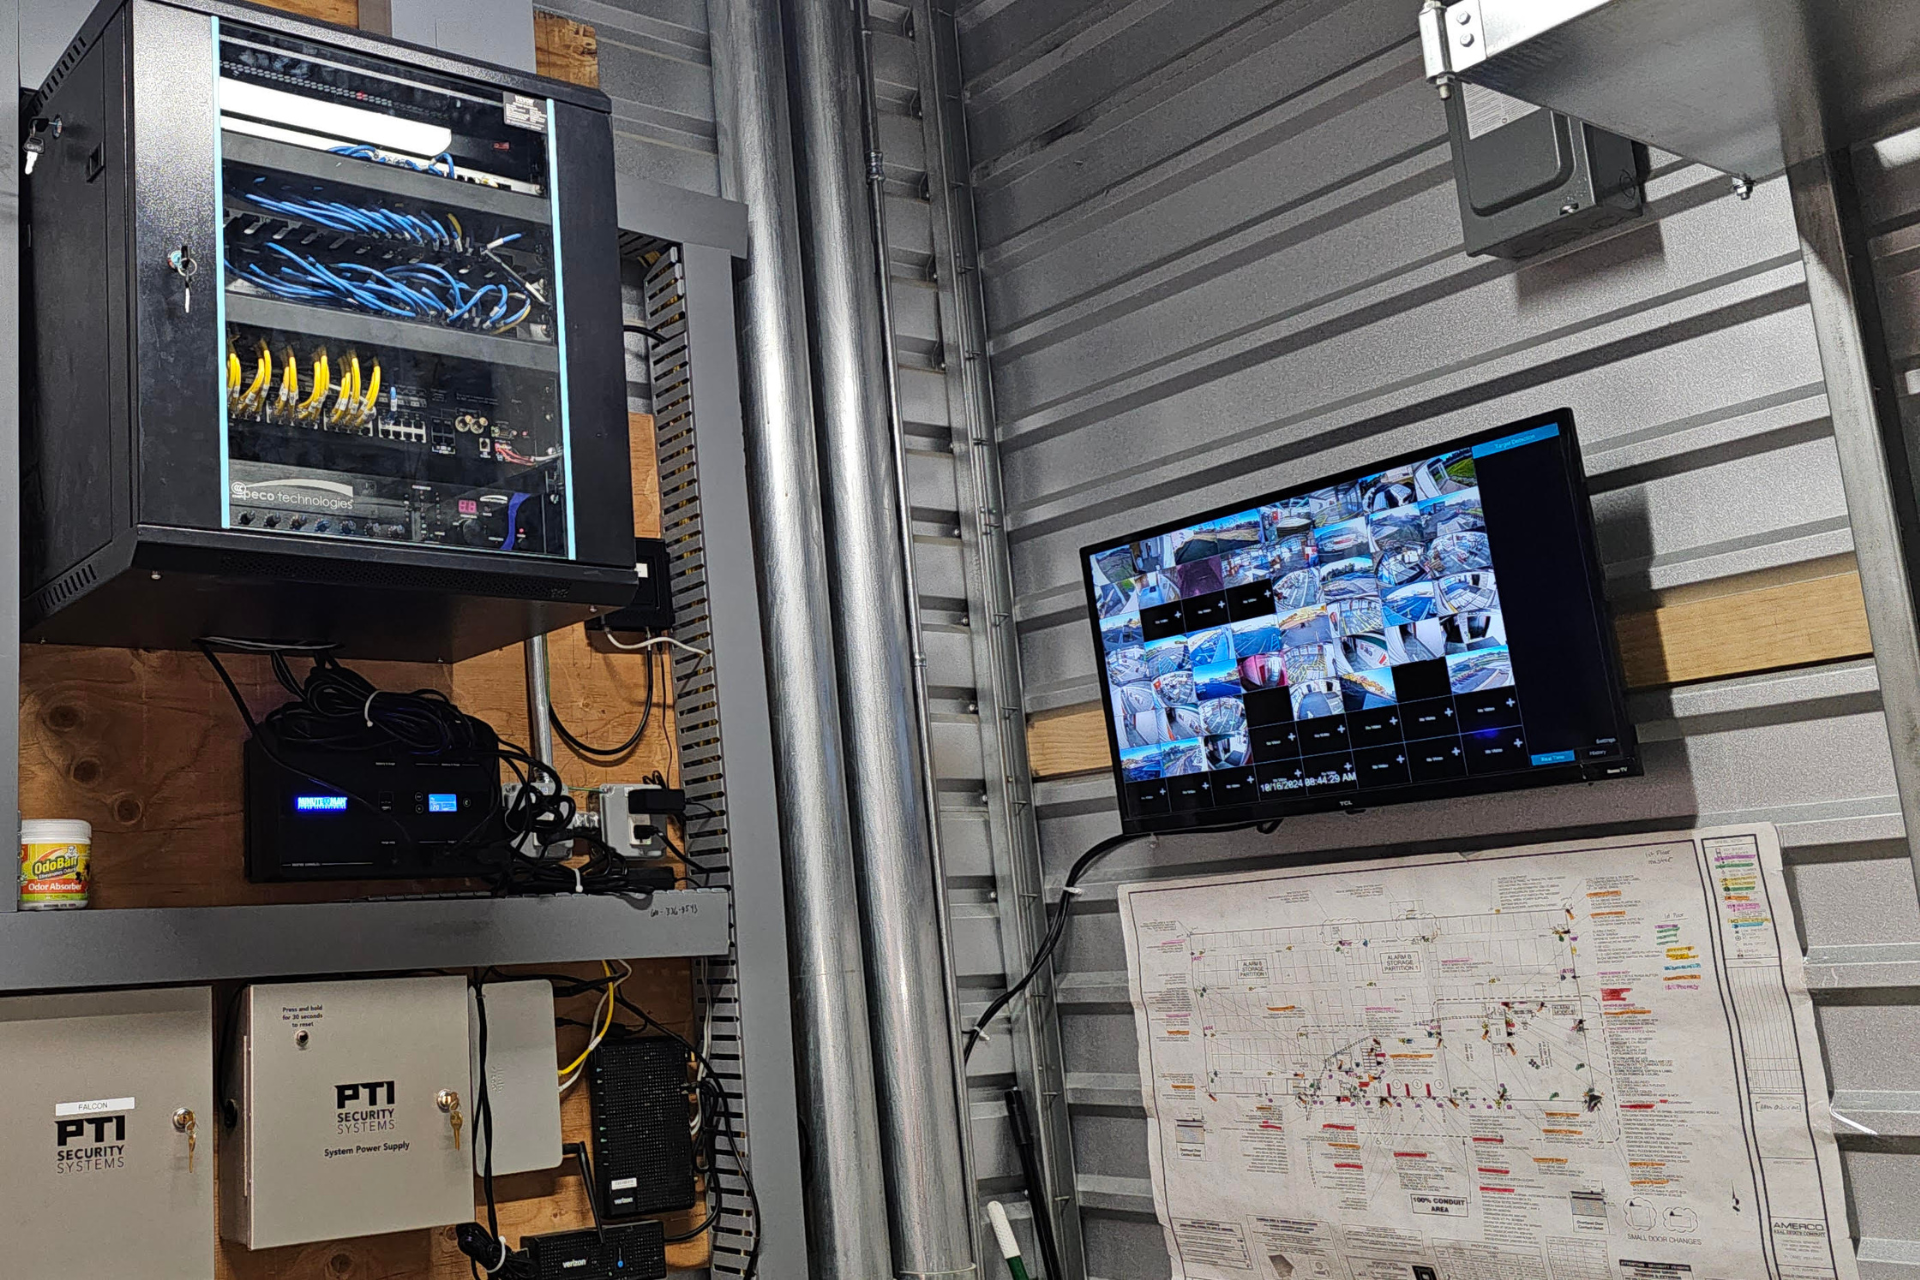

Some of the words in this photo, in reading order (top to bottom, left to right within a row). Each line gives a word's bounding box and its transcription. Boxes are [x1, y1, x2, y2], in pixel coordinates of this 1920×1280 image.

[238, 490, 275, 500] peco
[276, 490, 353, 510] technologies
[1342, 772, 1356, 782] AM
[34, 856, 78, 874] OdoBan
[49, 883, 82, 891] Absorber
[334, 1080, 395, 1109] PTI
[78, 1102, 108, 1110] FALCON
[337, 1108, 395, 1123] SECURITY
[54, 1115, 125, 1146] PTI
[337, 1119, 395, 1134] SYSTEMS
[57, 1144, 125, 1161] SECURITY
[324, 1148, 353, 1158] System
[356, 1144, 381, 1154] Power
[383, 1141, 410, 1151] Supply
[57, 1156, 124, 1174] SYSTEMS
[1773, 1222, 1824, 1231] AMERCO
[1669, 1237, 1702, 1245] CHANGES
[562, 1258, 588, 1268] verizon
